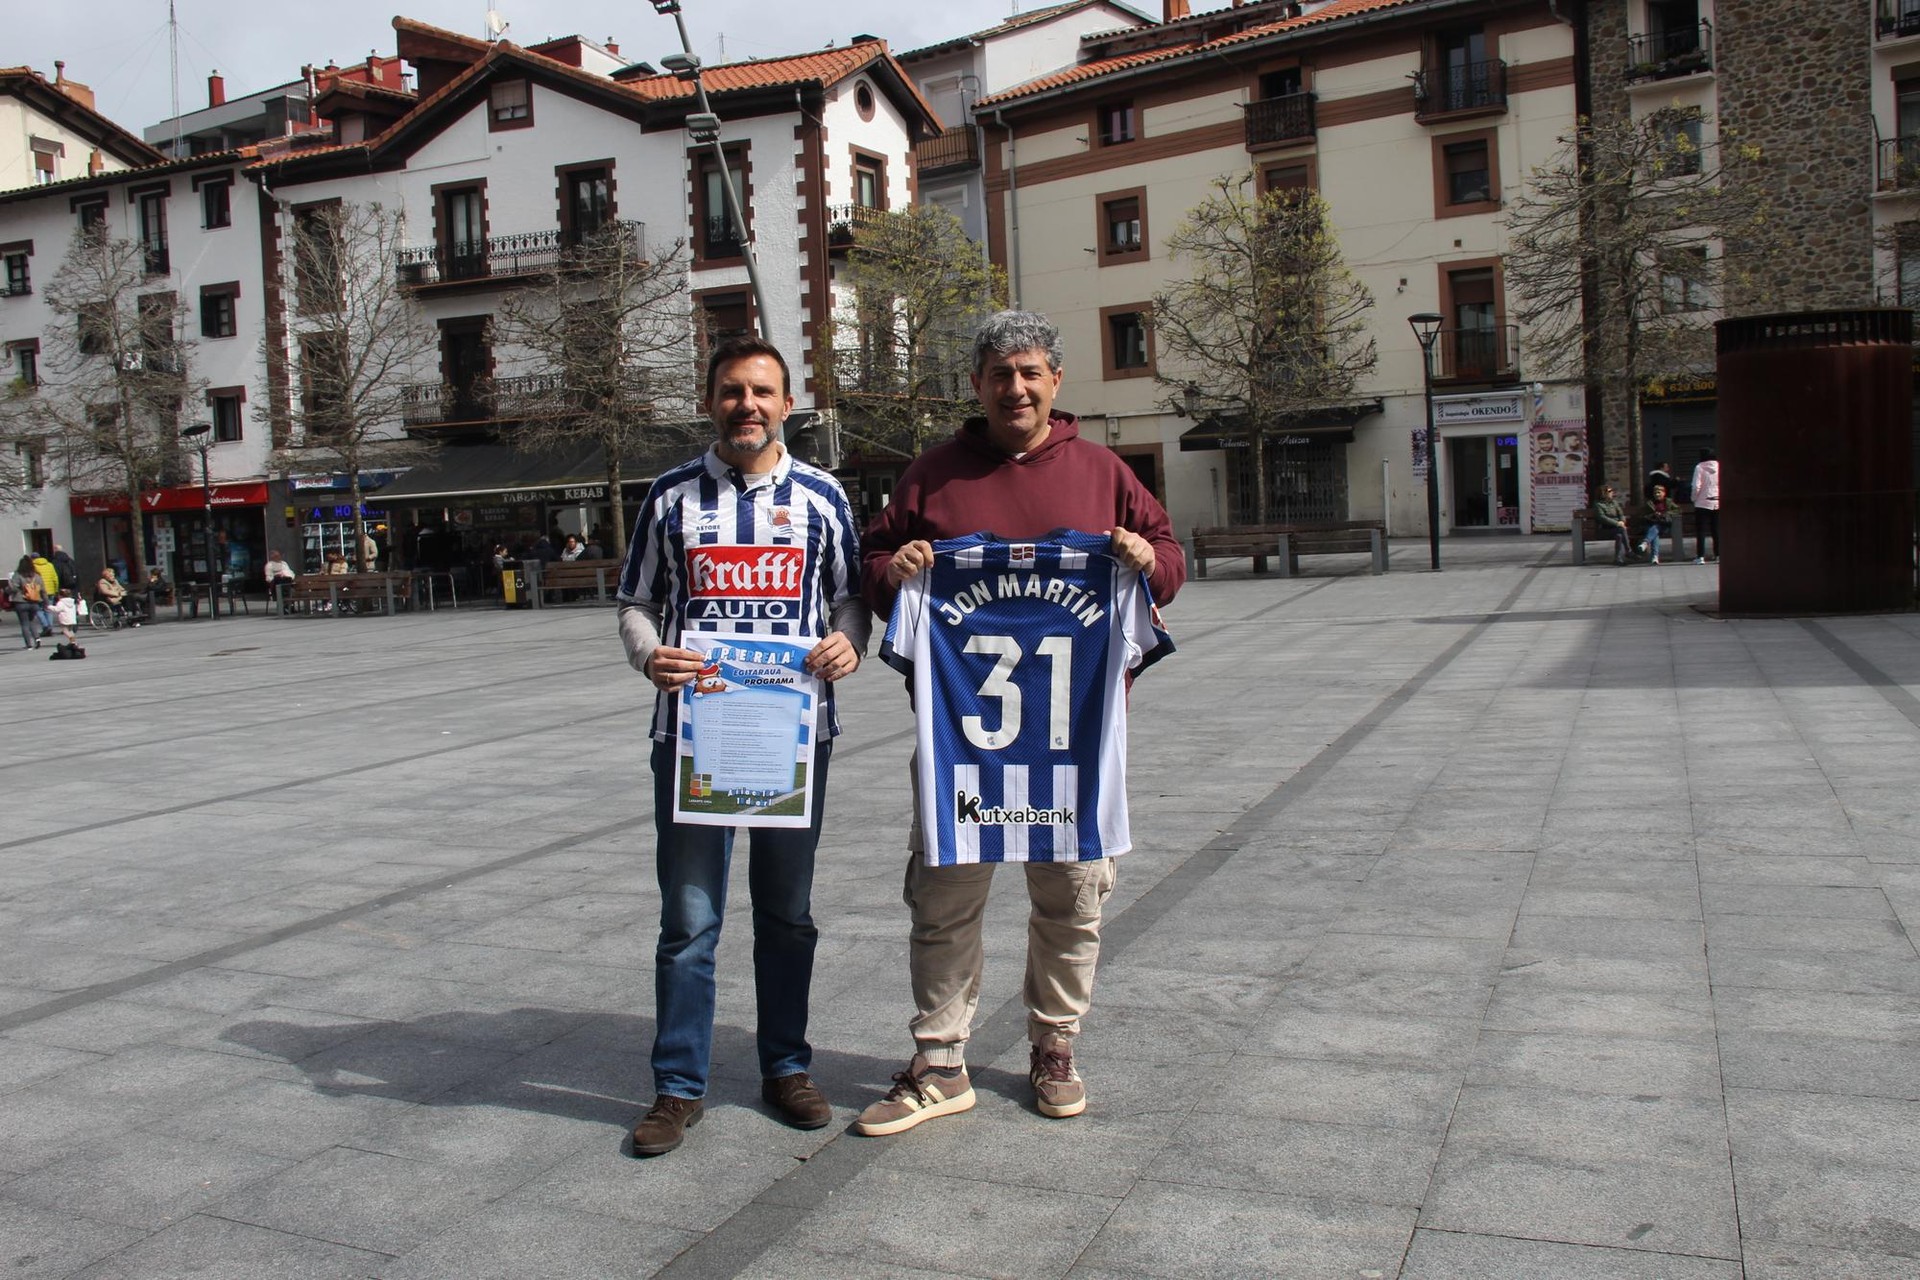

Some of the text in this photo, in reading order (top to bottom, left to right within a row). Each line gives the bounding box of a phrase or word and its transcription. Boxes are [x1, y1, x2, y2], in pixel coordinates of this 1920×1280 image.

[1471, 406, 1511, 416] OKENDO
[502, 487, 604, 503] TABERNA KEBAB
[939, 573, 1105, 628] JON MARTÍN
[702, 600, 788, 619] AUTO
[704, 647, 736, 661] AUPA
[734, 668, 782, 676] EGITARAUA
[744, 677, 794, 686] PROGRAMA
[961, 634, 1073, 751] 31
[957, 790, 1075, 825] Kutxabank
